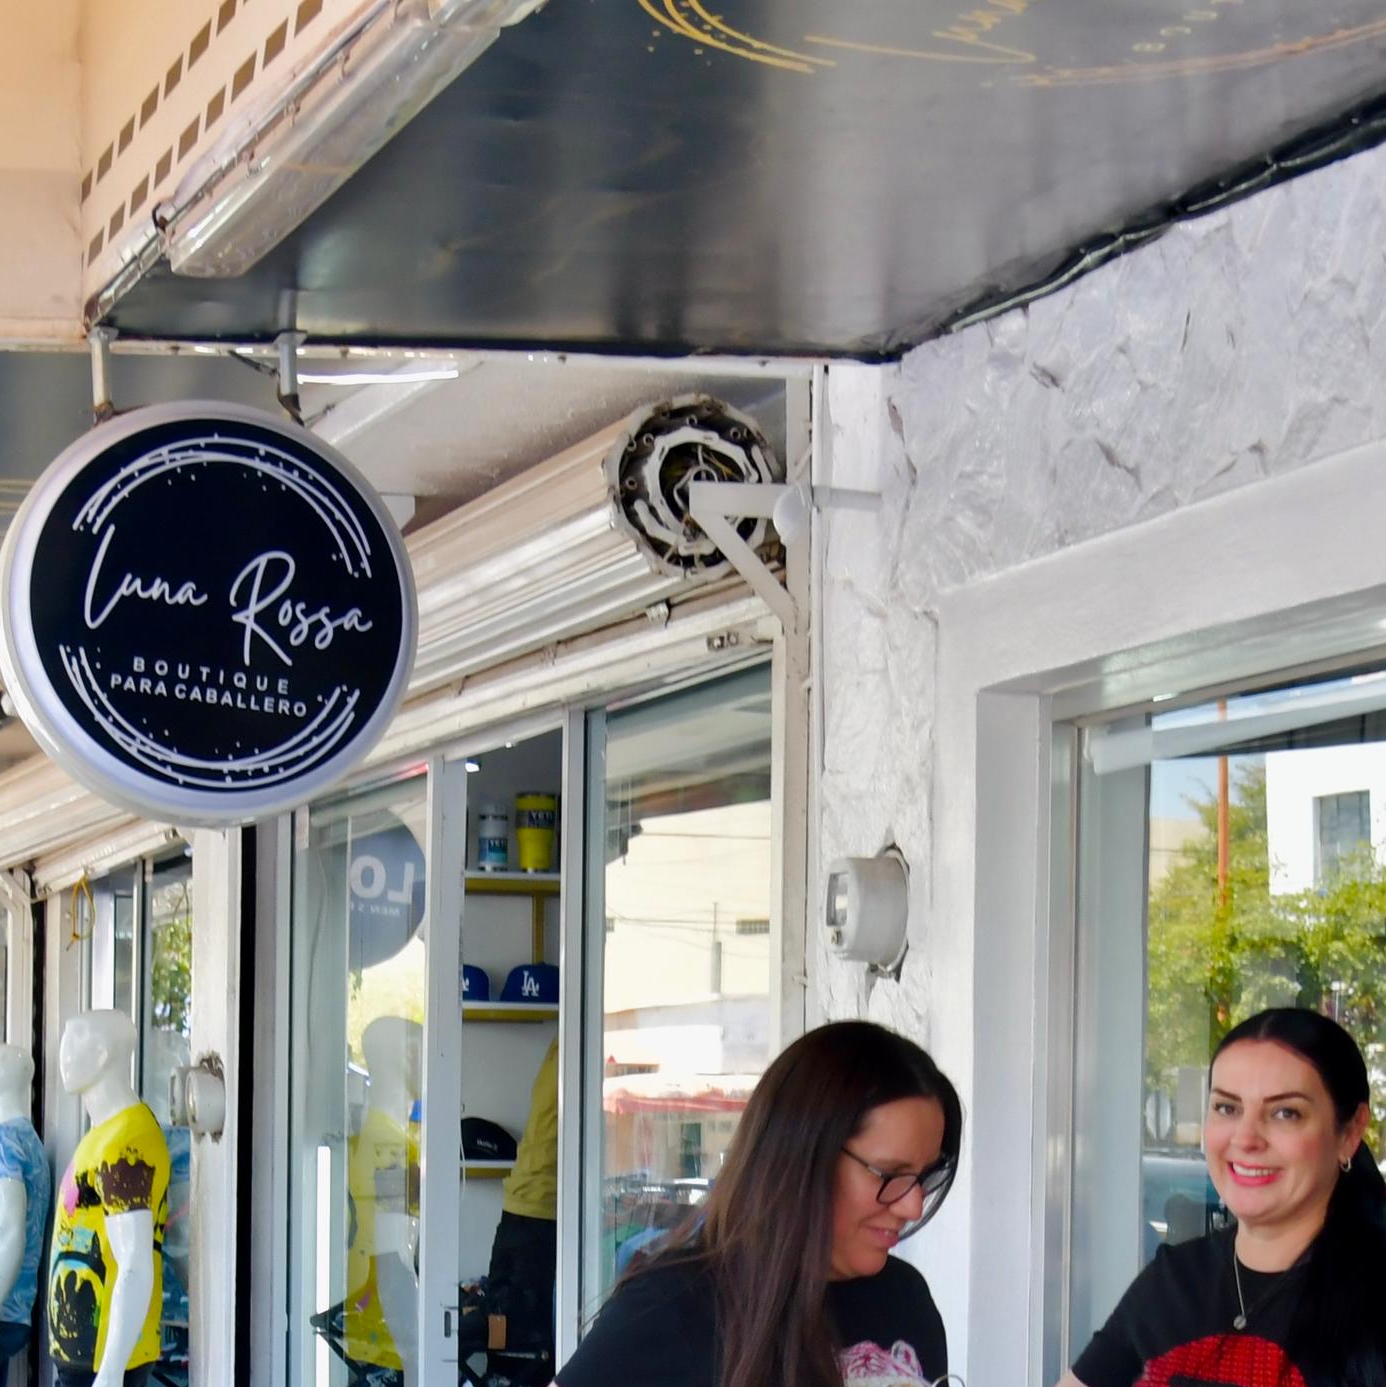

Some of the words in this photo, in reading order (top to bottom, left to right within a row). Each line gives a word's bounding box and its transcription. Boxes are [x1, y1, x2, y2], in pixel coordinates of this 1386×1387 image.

[84, 524, 208, 629] Luna
[229, 551, 373, 667] Rossa
[133, 656, 290, 695] BOUTIQUE
[110, 675, 168, 698] PARA
[174, 681, 308, 718] CABALLERO
[521, 970, 540, 997] LA
